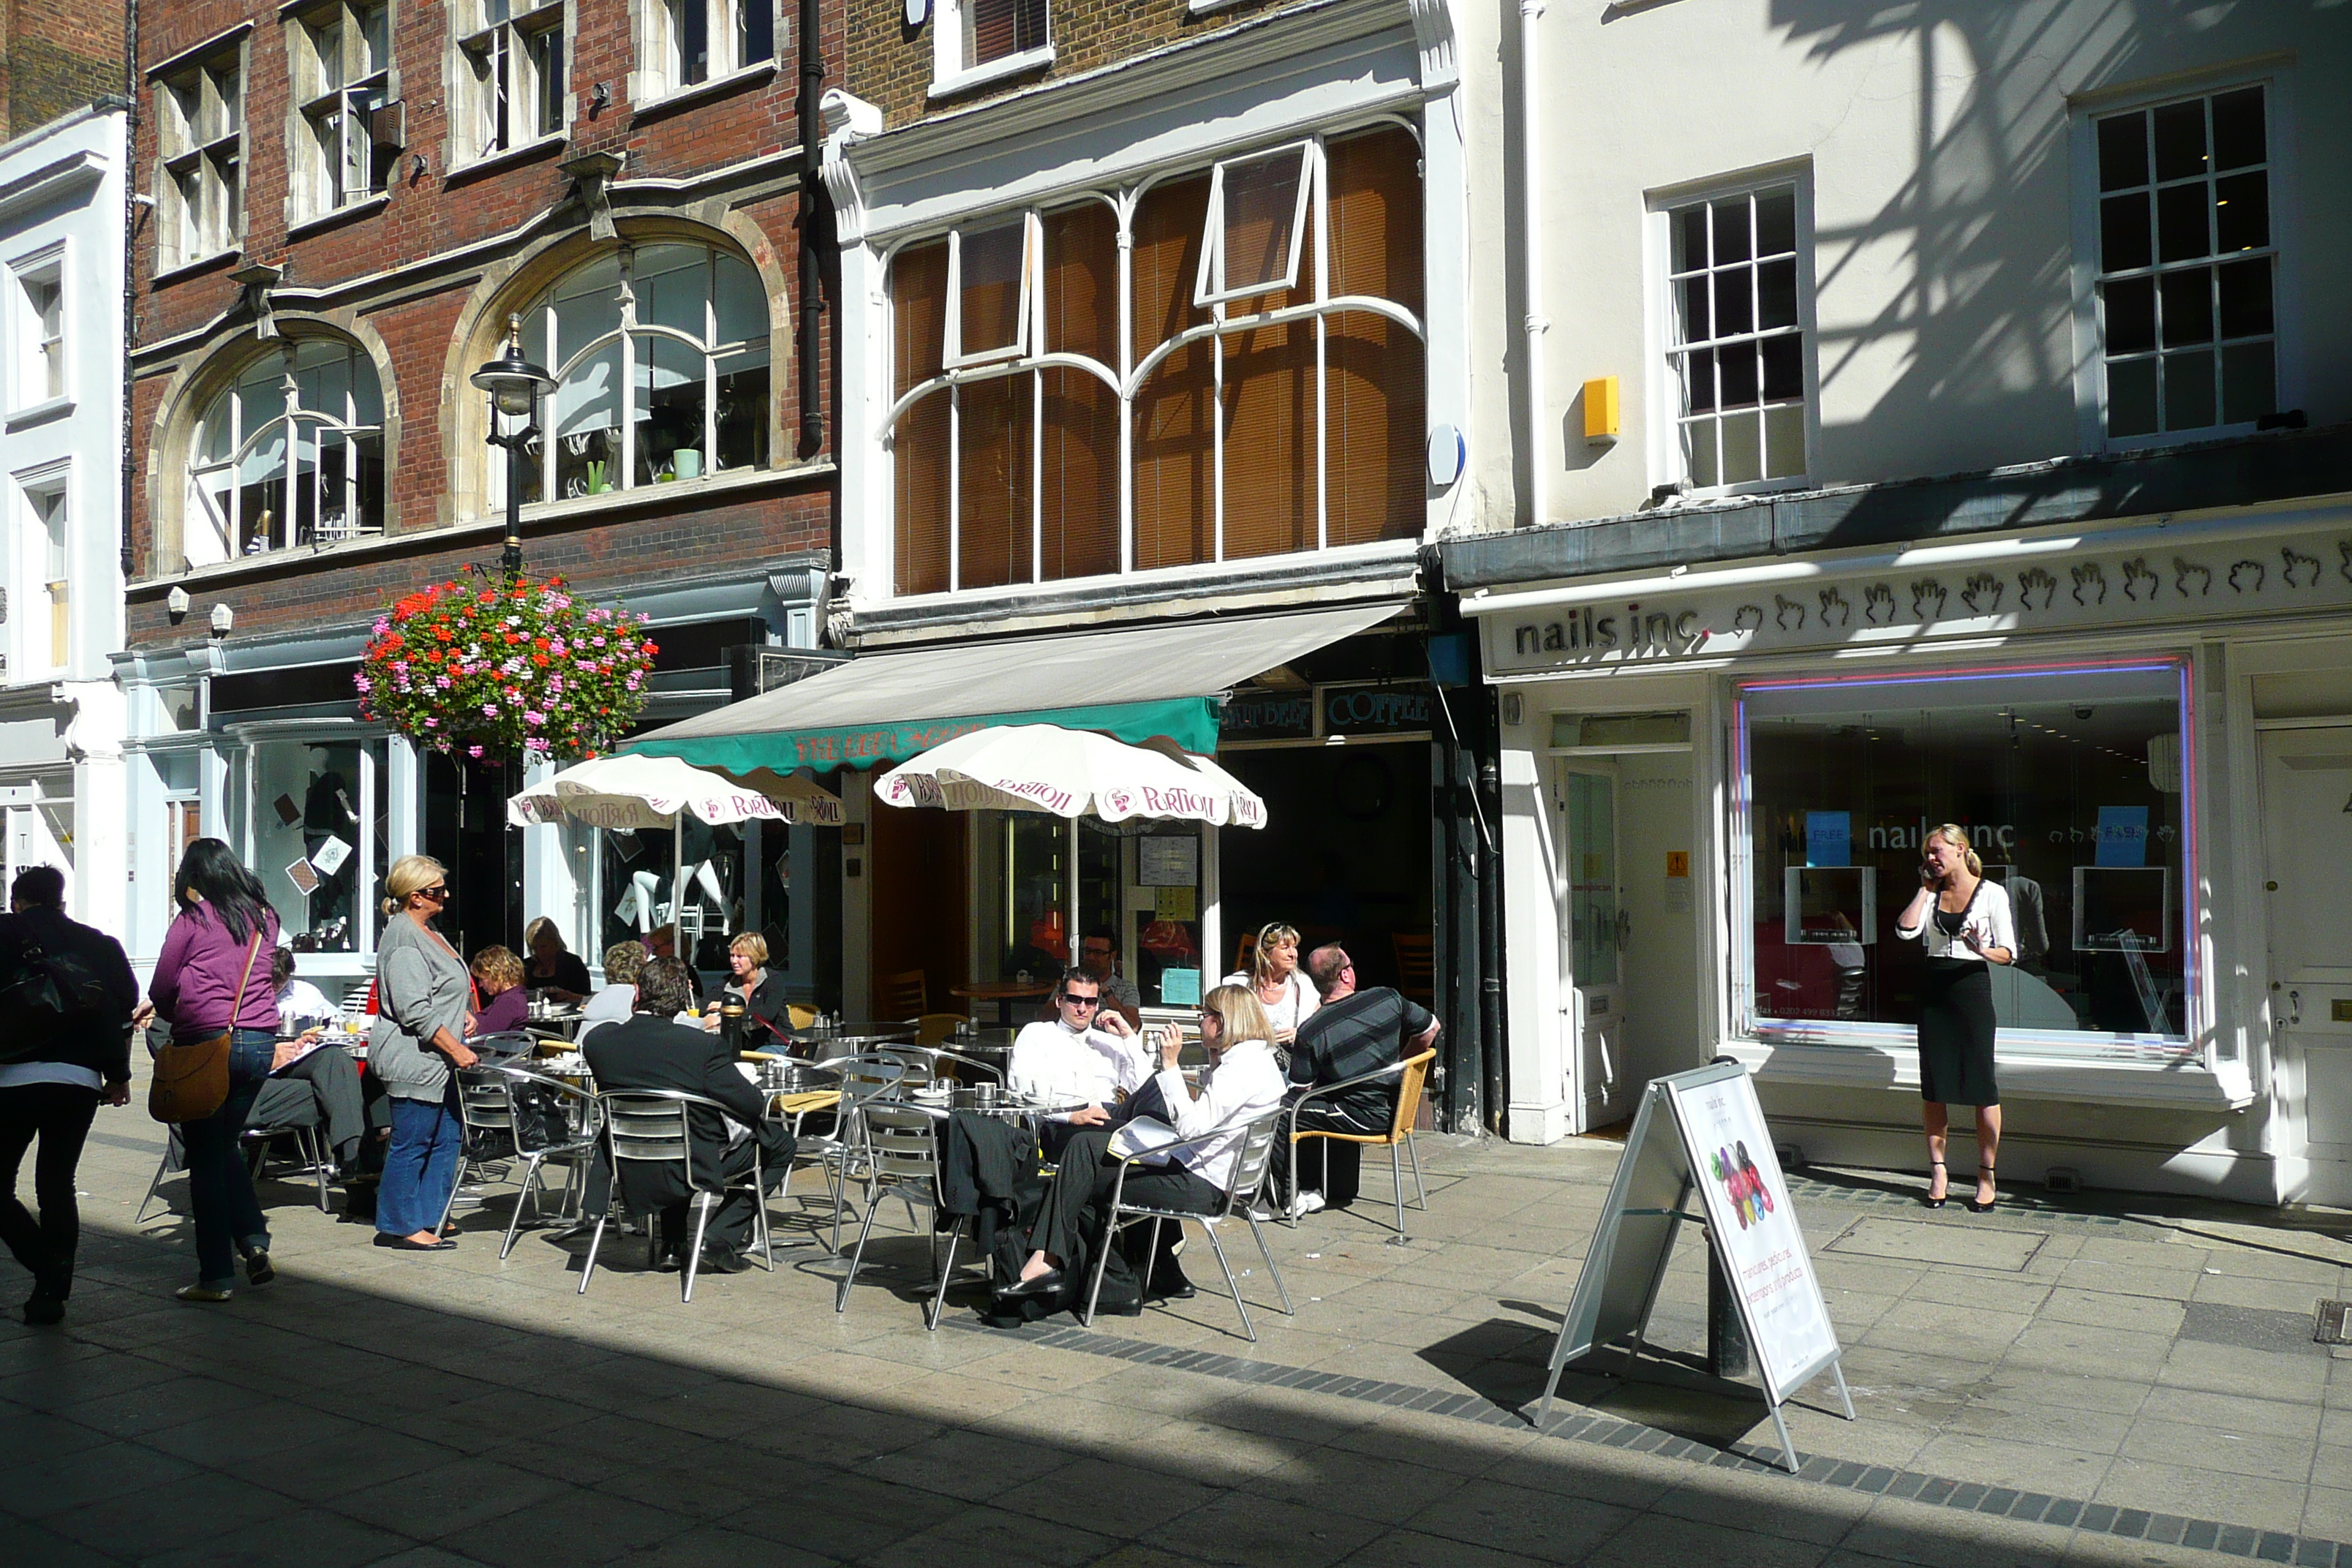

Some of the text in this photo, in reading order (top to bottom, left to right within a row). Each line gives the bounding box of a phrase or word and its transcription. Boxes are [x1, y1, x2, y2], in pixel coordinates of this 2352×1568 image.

[1515, 606, 1616, 655] nails
[1264, 699, 1310, 730] BEEF
[1328, 690, 1429, 726] COFFEE
[1813, 829, 1844, 840] FREE
[1869, 815, 1927, 849] nail
[1802, 1007, 1818, 1016] 499
